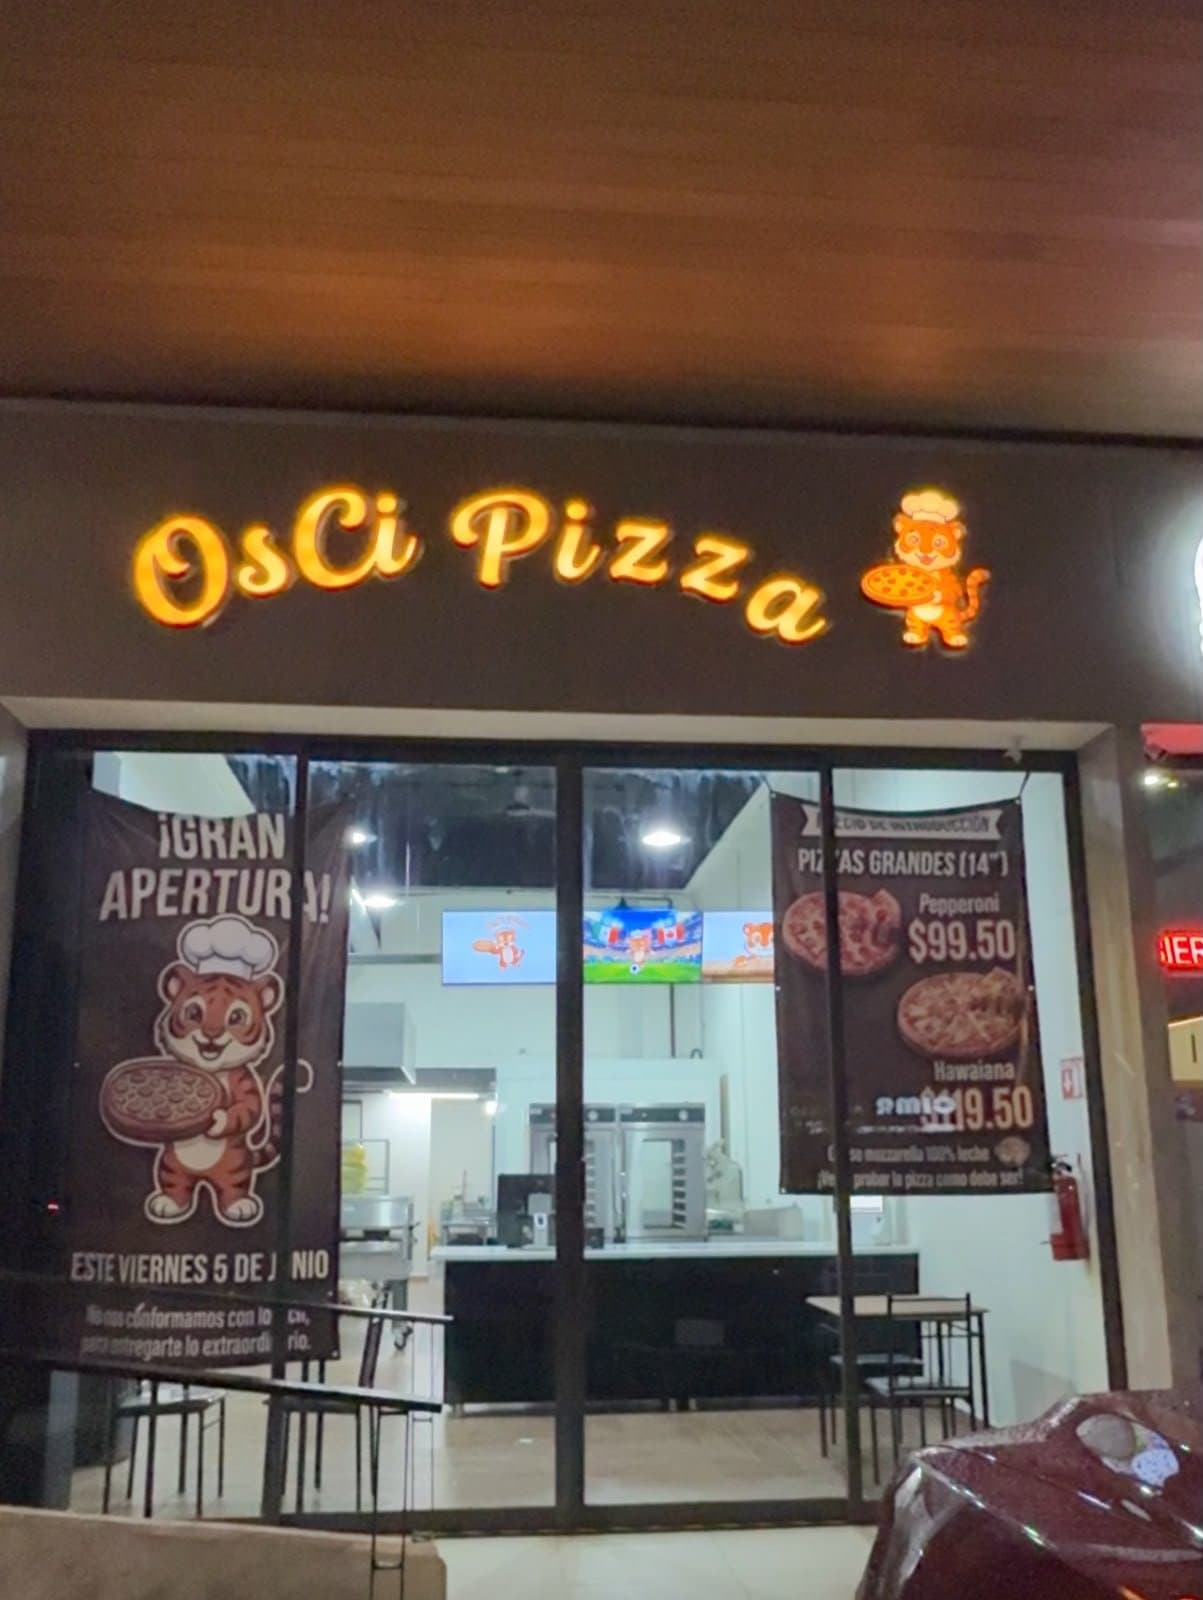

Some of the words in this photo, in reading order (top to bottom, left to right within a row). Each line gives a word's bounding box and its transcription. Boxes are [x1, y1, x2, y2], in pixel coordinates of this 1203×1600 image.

[451, 490, 827, 643] Pizza
[158, 812, 286, 860] ¡GRAN
[797, 847, 865, 875] PIZAS
[869, 849, 956, 877] GRANDES
[918, 892, 1000, 917] Pepperoni
[907, 919, 1016, 963] $99.50
[1160, 936, 1203, 965] IER
[933, 1060, 1016, 1082] Hawaiana
[69, 1252, 115, 1281] ESTE
[117, 1253, 209, 1284] VIERNES
[212, 1253, 229, 1284] 5
[233, 1253, 263, 1282] DE
[267, 1249, 329, 1282] JNIO
[226, 1308, 256, 1328] con
[257, 1305, 273, 1327] lo
[184, 1333, 200, 1357] lo
[202, 1330, 313, 1357] extraordirio.
